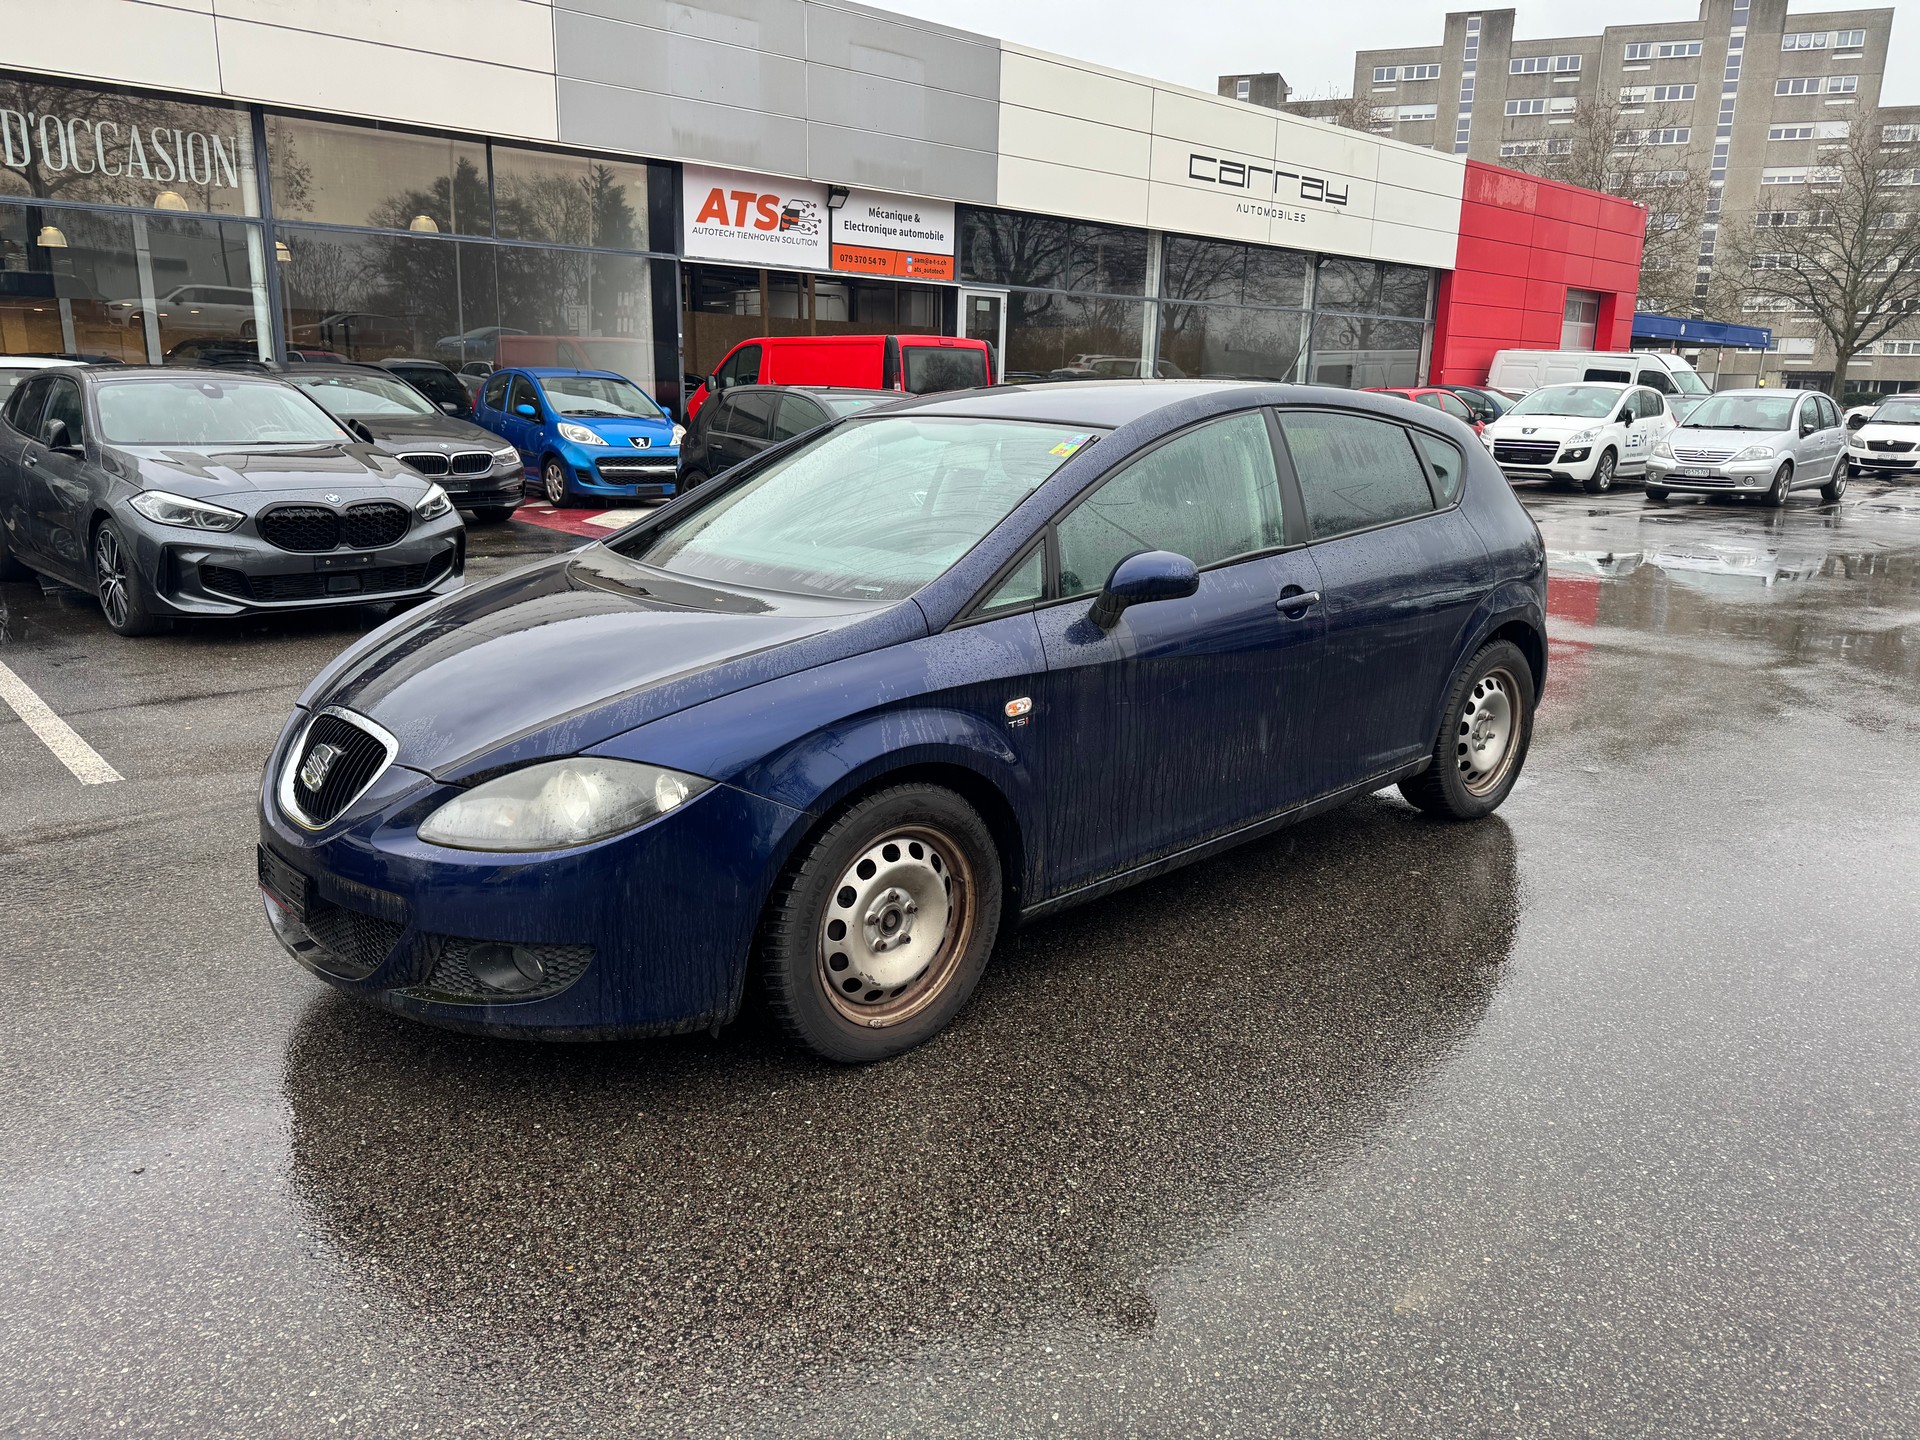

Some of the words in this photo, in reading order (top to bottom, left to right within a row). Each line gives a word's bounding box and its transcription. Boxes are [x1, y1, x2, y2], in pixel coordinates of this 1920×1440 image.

[0, 109, 239, 189] D'OCCASION
[695, 187, 780, 231] ATS
[868, 206, 913, 223] Mécanique
[914, 213, 921, 223] &
[1236, 203, 1307, 223] AUTOMOBILES
[692, 227, 735, 238] AUTOTECH
[736, 231, 780, 243] TIENHOVEN
[781, 236, 819, 247] SOLUTION
[844, 220, 897, 237] Electronique
[898, 228, 944, 242] automobile
[839, 253, 853, 263] 079
[854, 255, 867, 264] 370
[868, 256, 877, 265] 54
[878, 257, 887, 266] 79
[1625, 434, 1647, 447] LEM
[797, 873, 829, 957] KUMHO
